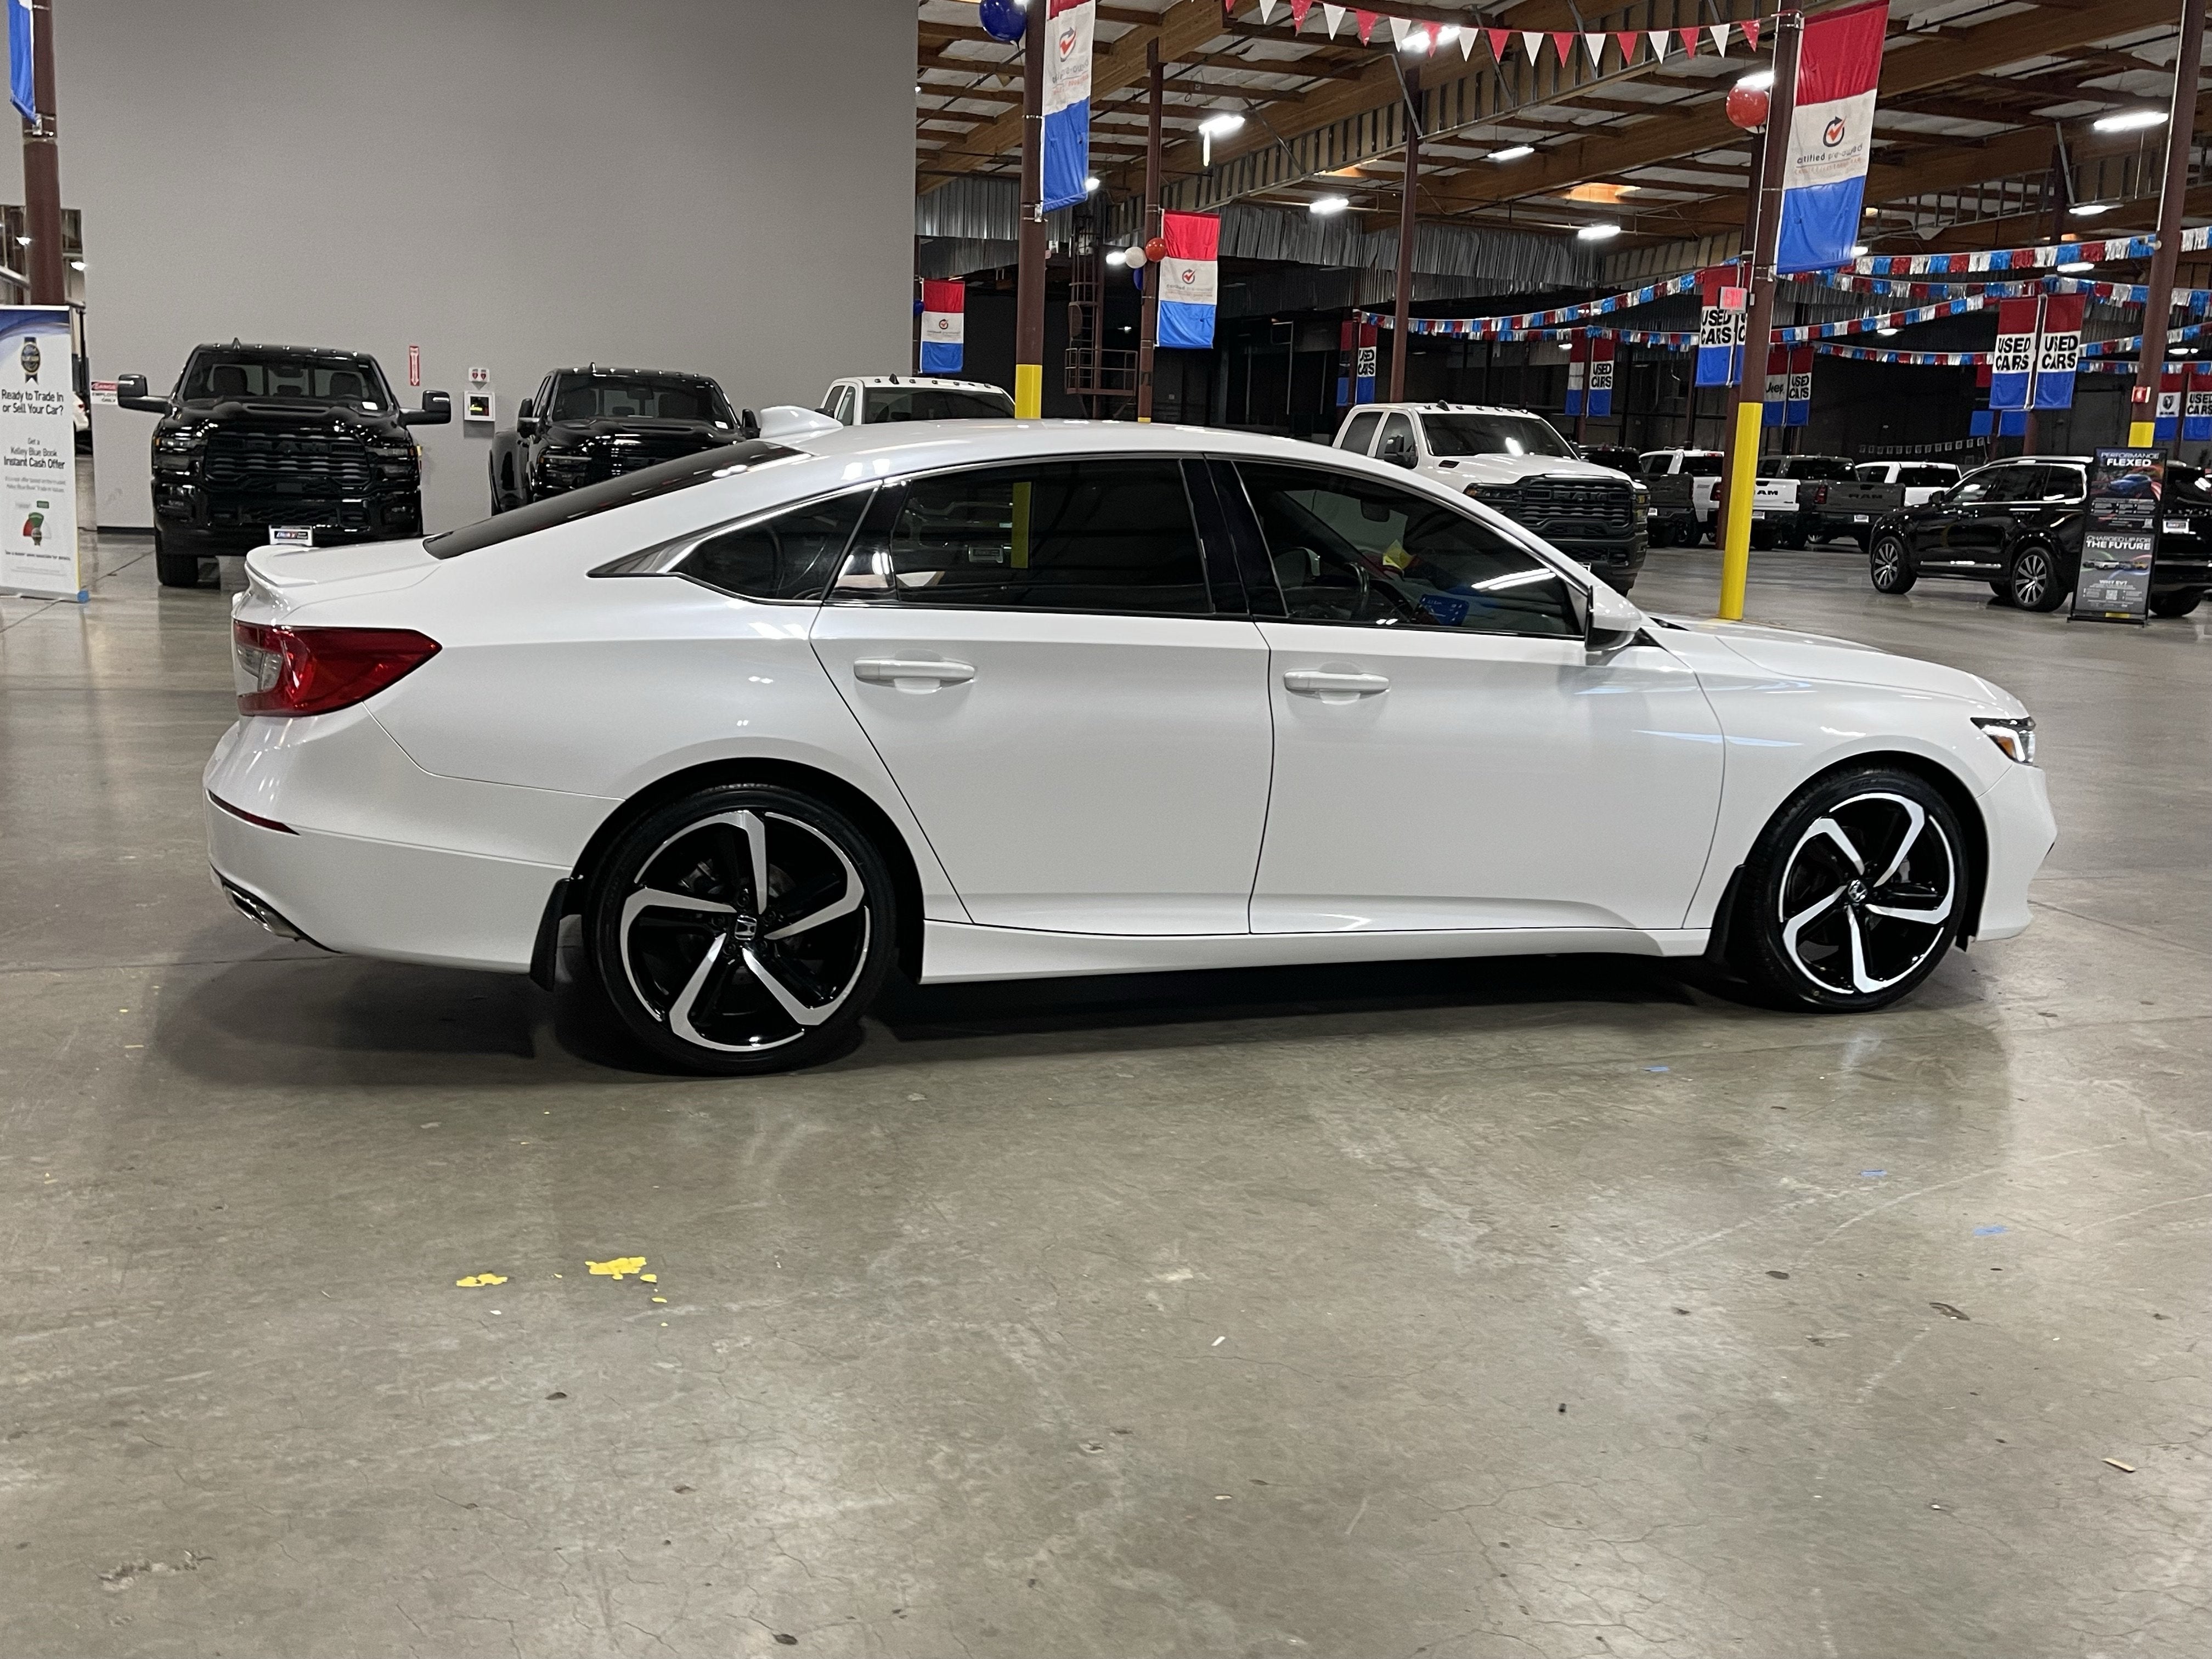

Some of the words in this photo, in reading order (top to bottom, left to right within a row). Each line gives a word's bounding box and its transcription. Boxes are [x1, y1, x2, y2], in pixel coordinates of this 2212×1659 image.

[1702, 309, 1732, 326] USED
[1701, 326, 1732, 345] CARS
[2045, 335, 2079, 352] USED
[1998, 337, 2031, 353] USED
[1995, 354, 2030, 371] CARS
[2041, 353, 2077, 369] CARS
[1, 389, 24, 403] Ready
[25, 391, 33, 400] to
[33, 390, 55, 402] Trade
[57, 392, 64, 402] In
[3, 404, 11, 413] or
[13, 402, 26, 413] Sell
[27, 403, 44, 414] Your
[46, 404, 64, 416] Car?
[29, 457, 46, 468] Cash
[2107, 458, 2152, 467] FLEXED
[2108, 541, 2151, 550] FUTURE
